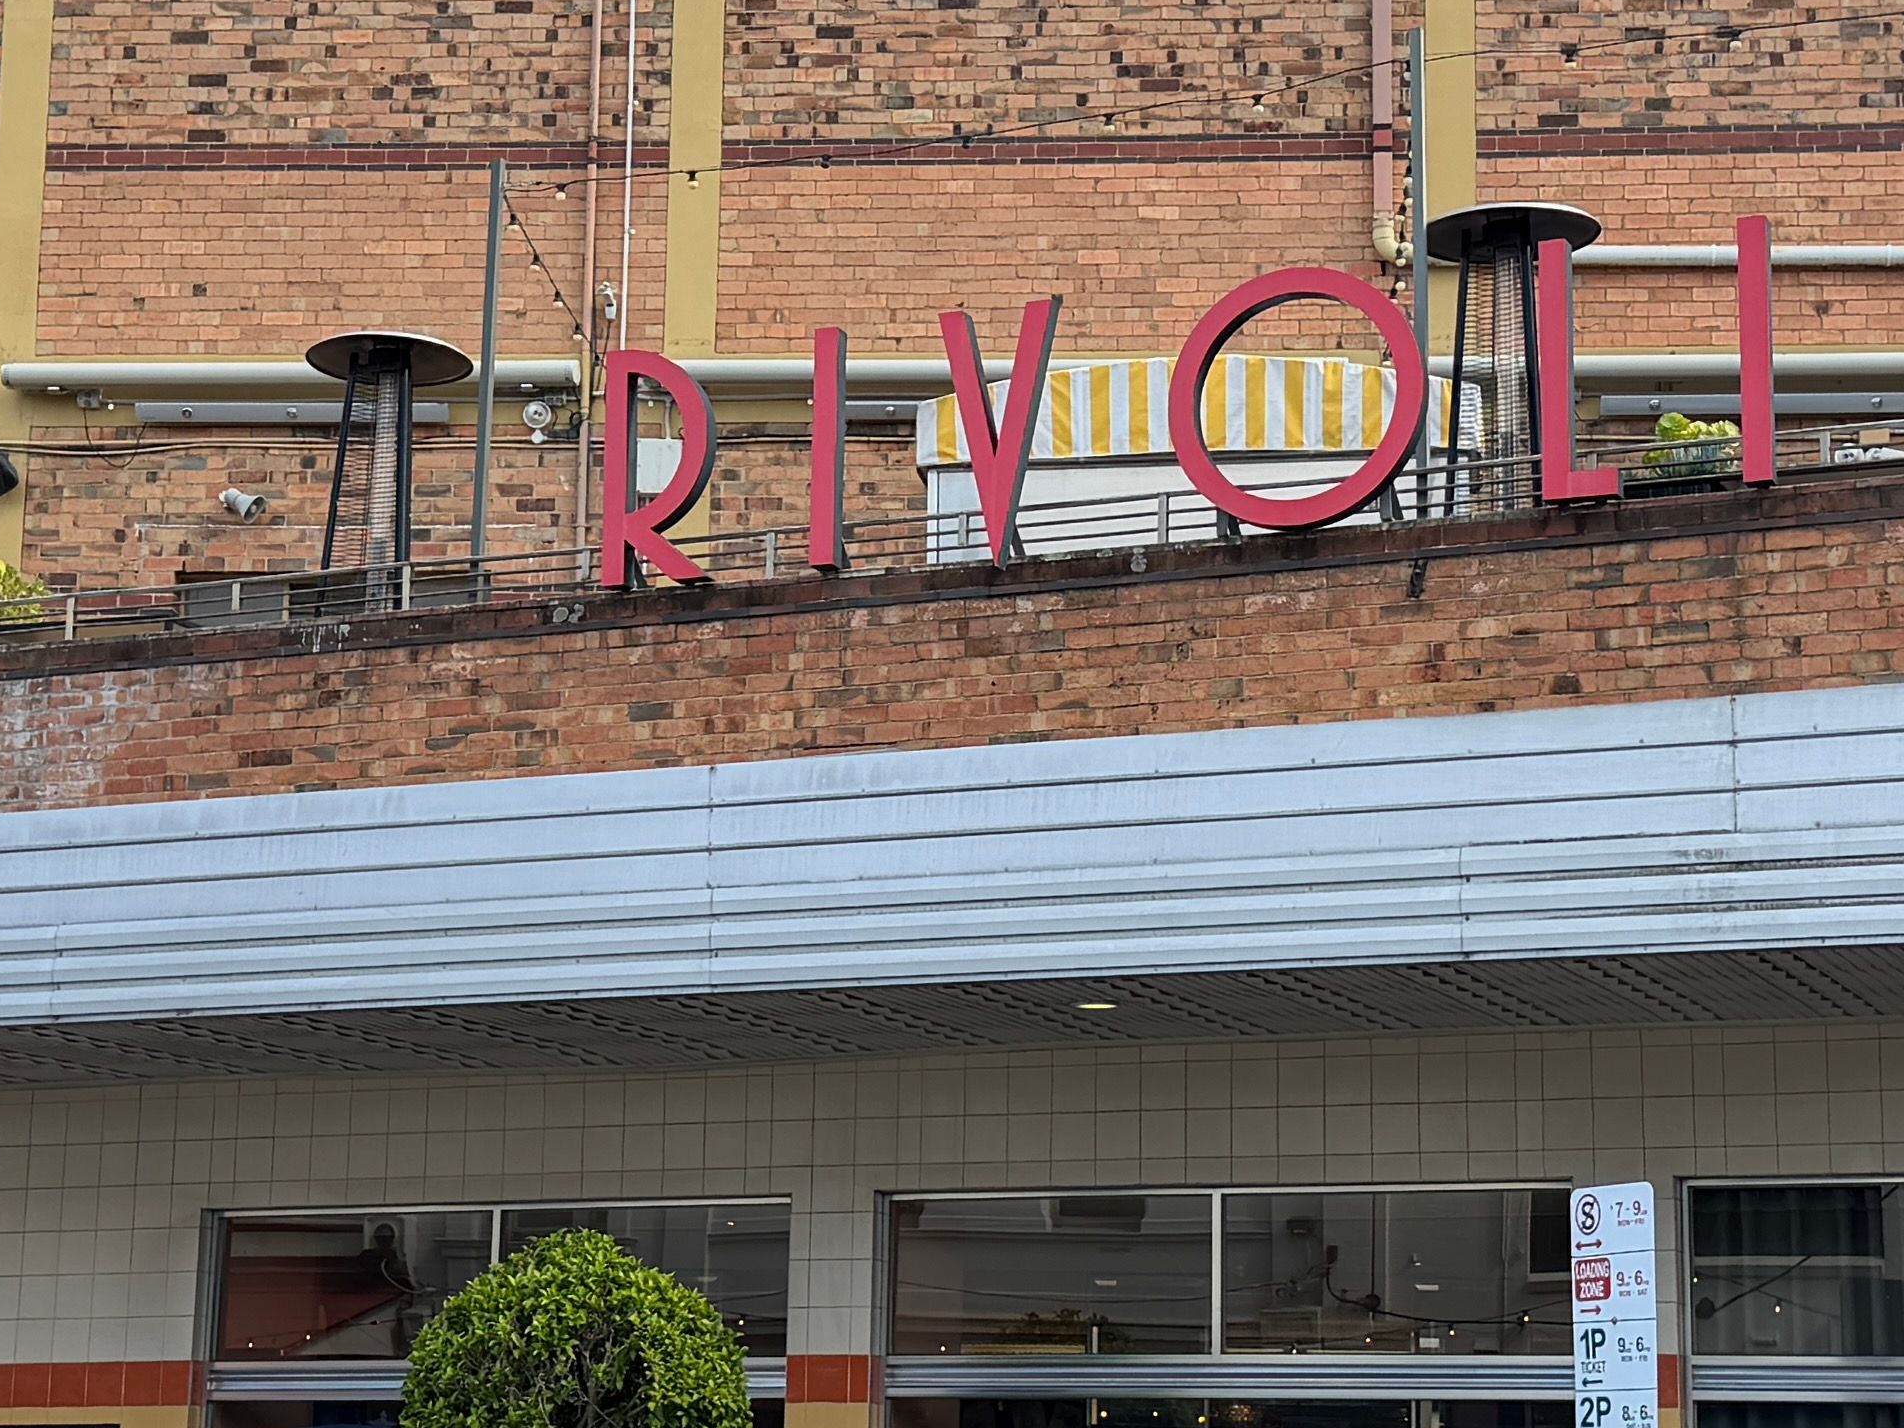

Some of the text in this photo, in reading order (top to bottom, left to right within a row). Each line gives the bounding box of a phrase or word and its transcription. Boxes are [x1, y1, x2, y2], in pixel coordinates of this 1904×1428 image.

[601, 214, 1777, 589] RIVOLI
[1576, 1260, 1610, 1280] LOADING
[1579, 1281, 1605, 1299] ZONE
[1580, 1328, 1607, 1360] 1P
[1581, 1360, 1607, 1374] TICKET
[1580, 1396, 1611, 1428] 2P
